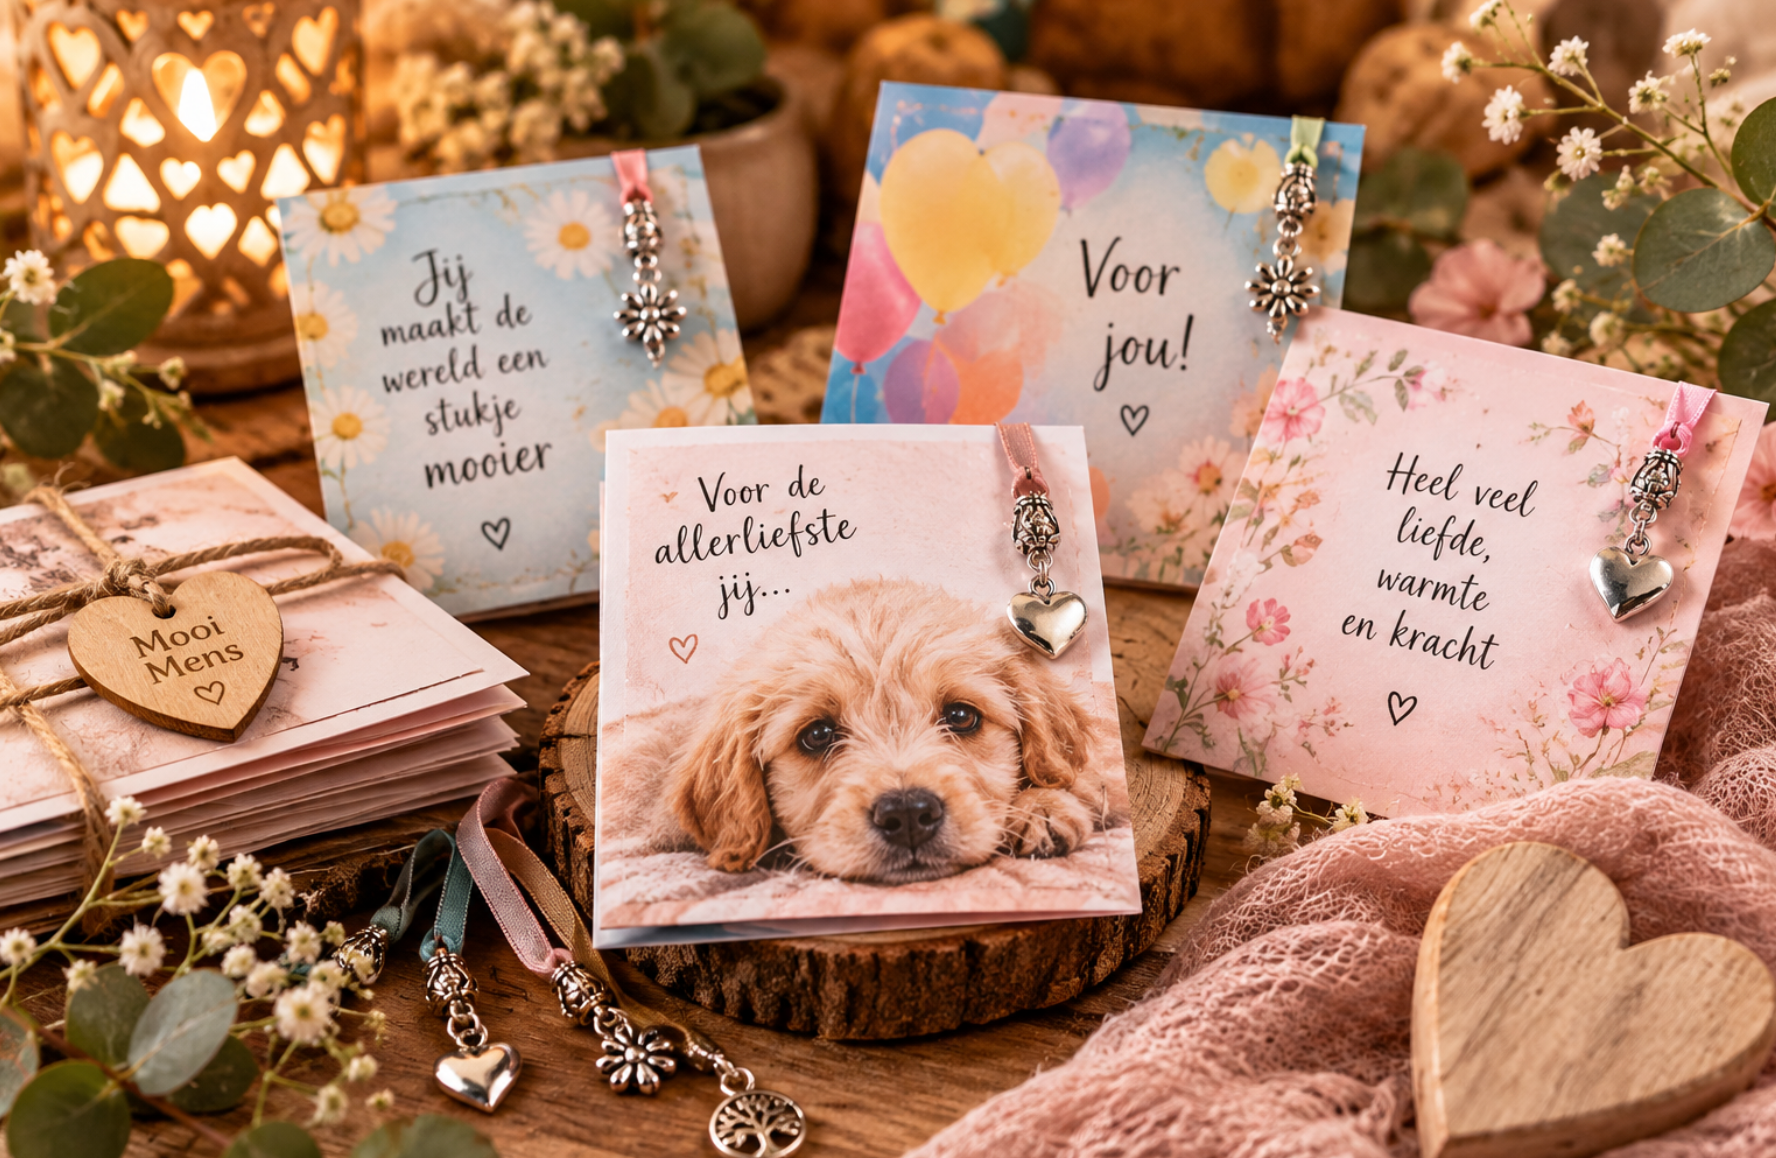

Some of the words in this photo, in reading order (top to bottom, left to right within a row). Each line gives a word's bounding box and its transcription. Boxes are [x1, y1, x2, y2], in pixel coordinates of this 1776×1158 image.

[411, 248, 473, 307] Jij
[1080, 236, 1180, 298] Voor
[381, 301, 482, 346] maakt
[496, 293, 532, 329] de
[382, 344, 483, 393] wereld
[498, 349, 548, 373] een
[1094, 313, 1194, 392] jou!
[425, 391, 521, 438] stukje
[425, 442, 552, 489] mooier
[698, 471, 769, 512] Voor
[788, 464, 825, 498] de
[1387, 452, 1464, 500] Heel
[1475, 480, 1538, 517] veel
[655, 508, 857, 564] allerliefste
[1397, 506, 1490, 563] liefde,
[718, 572, 790, 620] jij...
[1377, 569, 1490, 611] warmte
[130, 615, 225, 659] Mooi
[1342, 615, 1376, 640] en
[1389, 609, 1499, 670] kracht
[144, 644, 244, 685] Mens
